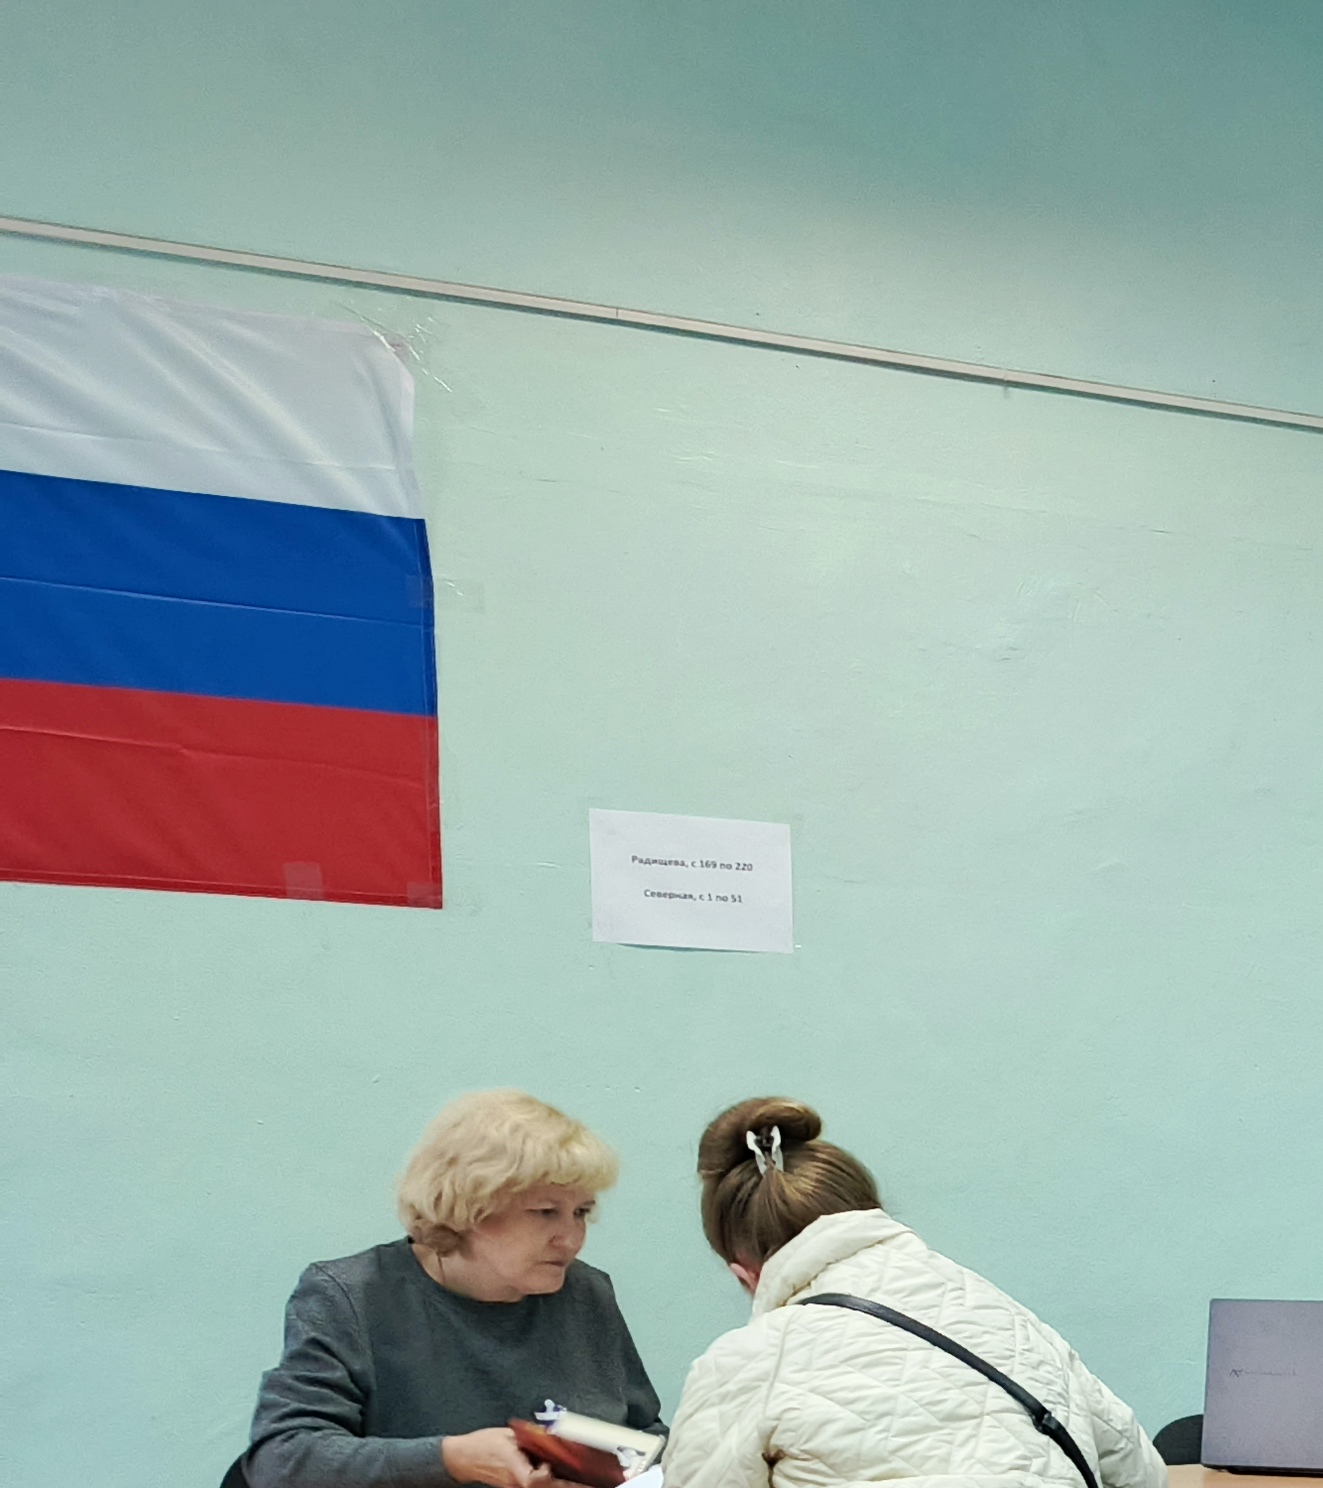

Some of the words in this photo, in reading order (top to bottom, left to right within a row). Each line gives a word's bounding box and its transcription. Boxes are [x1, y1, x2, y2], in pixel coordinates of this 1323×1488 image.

[631, 855, 689, 868] Радищева,
[699, 860, 717, 869] 169
[719, 862, 733, 870] по
[735, 862, 754, 872] 220
[644, 889, 697, 901] Северная,
[731, 894, 743, 904] 51
